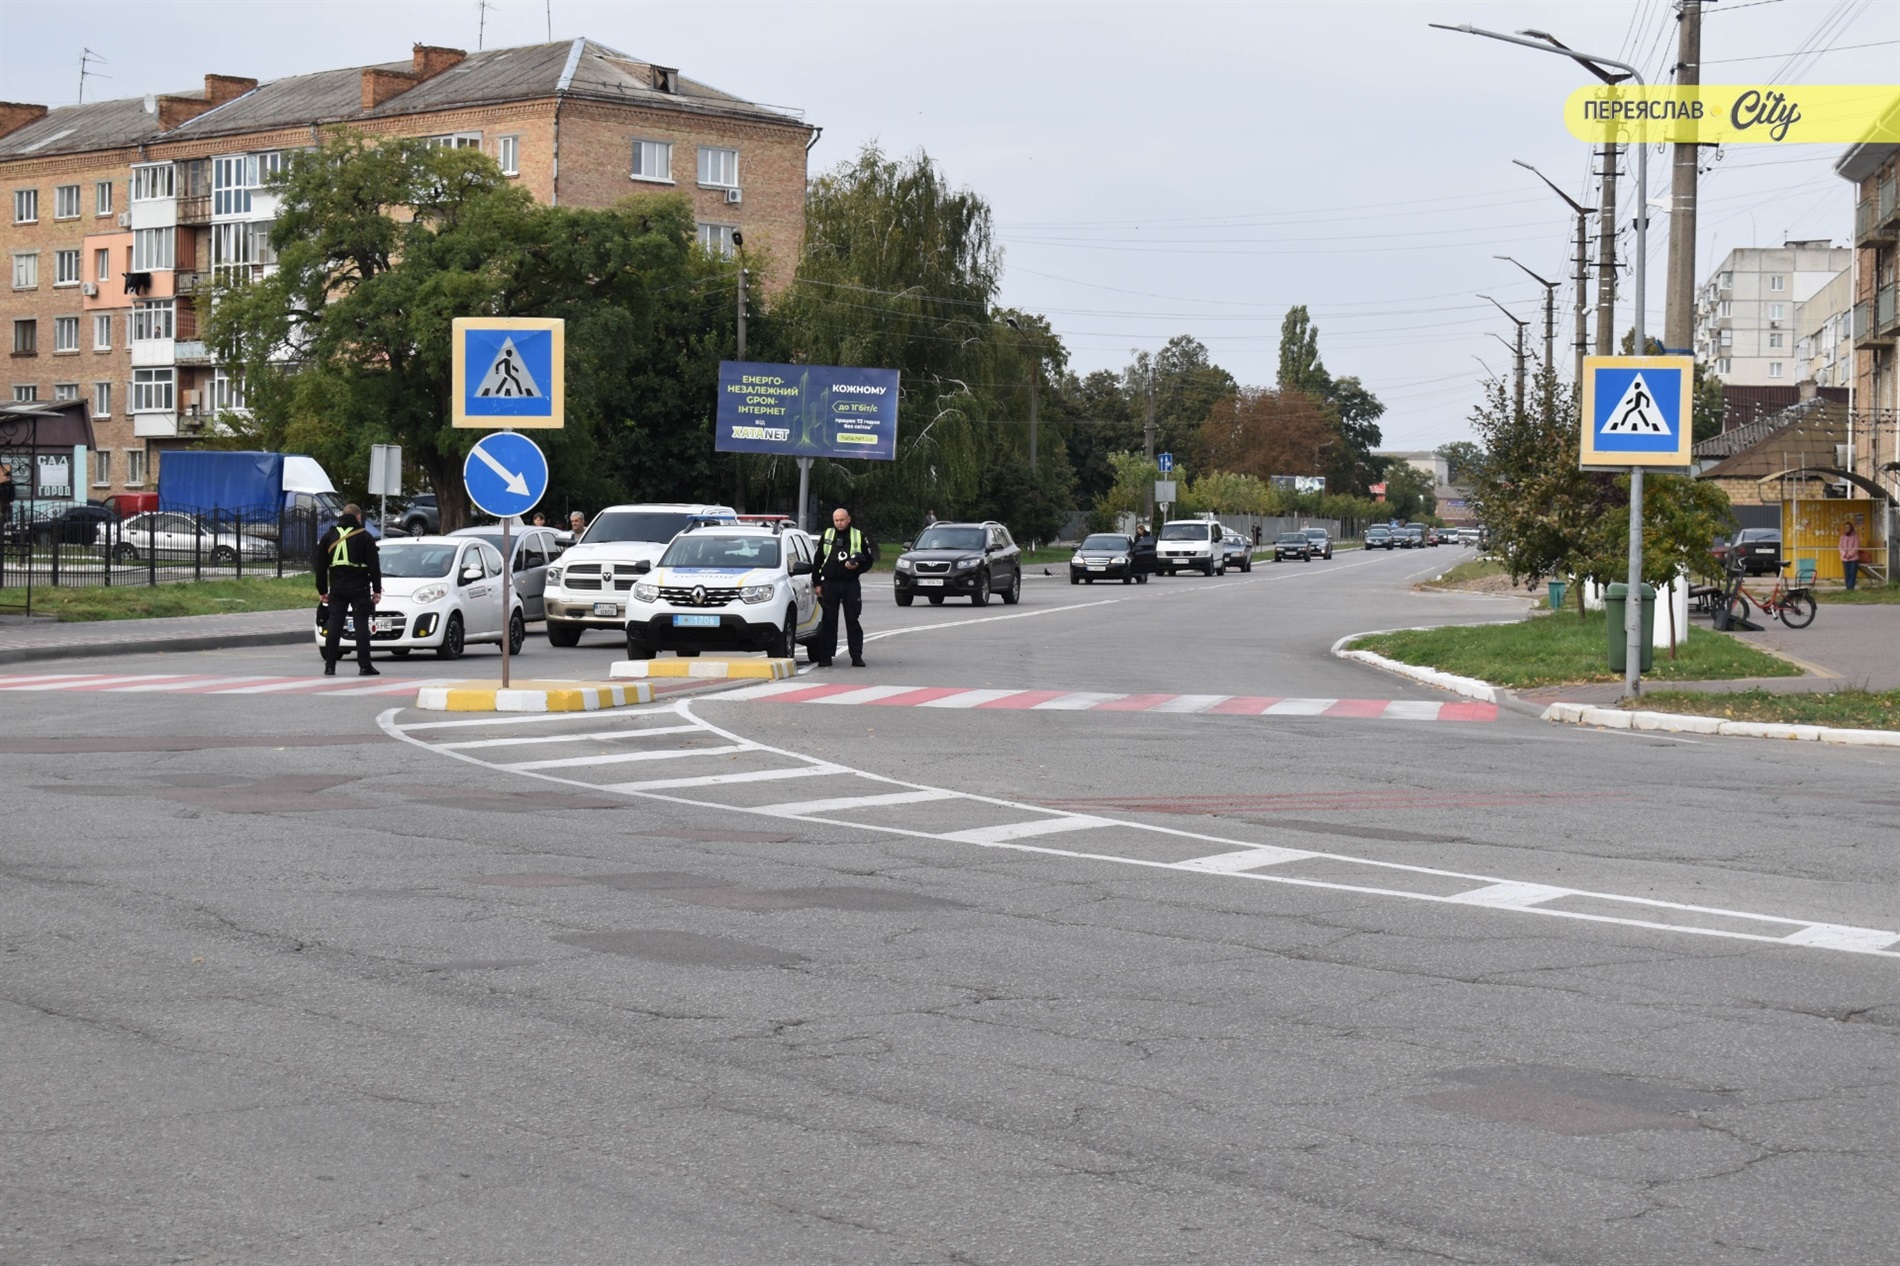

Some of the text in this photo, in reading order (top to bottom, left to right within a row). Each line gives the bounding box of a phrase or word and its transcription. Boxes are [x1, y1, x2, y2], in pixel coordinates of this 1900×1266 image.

[742, 375, 784, 385] ЕНЕРГО-
[727, 385, 799, 397] НЕЗАЛЕЖНИЙ
[832, 384, 887, 396] КОЖНОМУ
[746, 396, 779, 405] GPON-
[738, 405, 786, 415] ІНТЕРНЕТ
[838, 404, 849, 412] до
[37, 455, 69, 466] САД
[38, 486, 71, 497] ГОРОД
[694, 615, 715, 625] 1706
